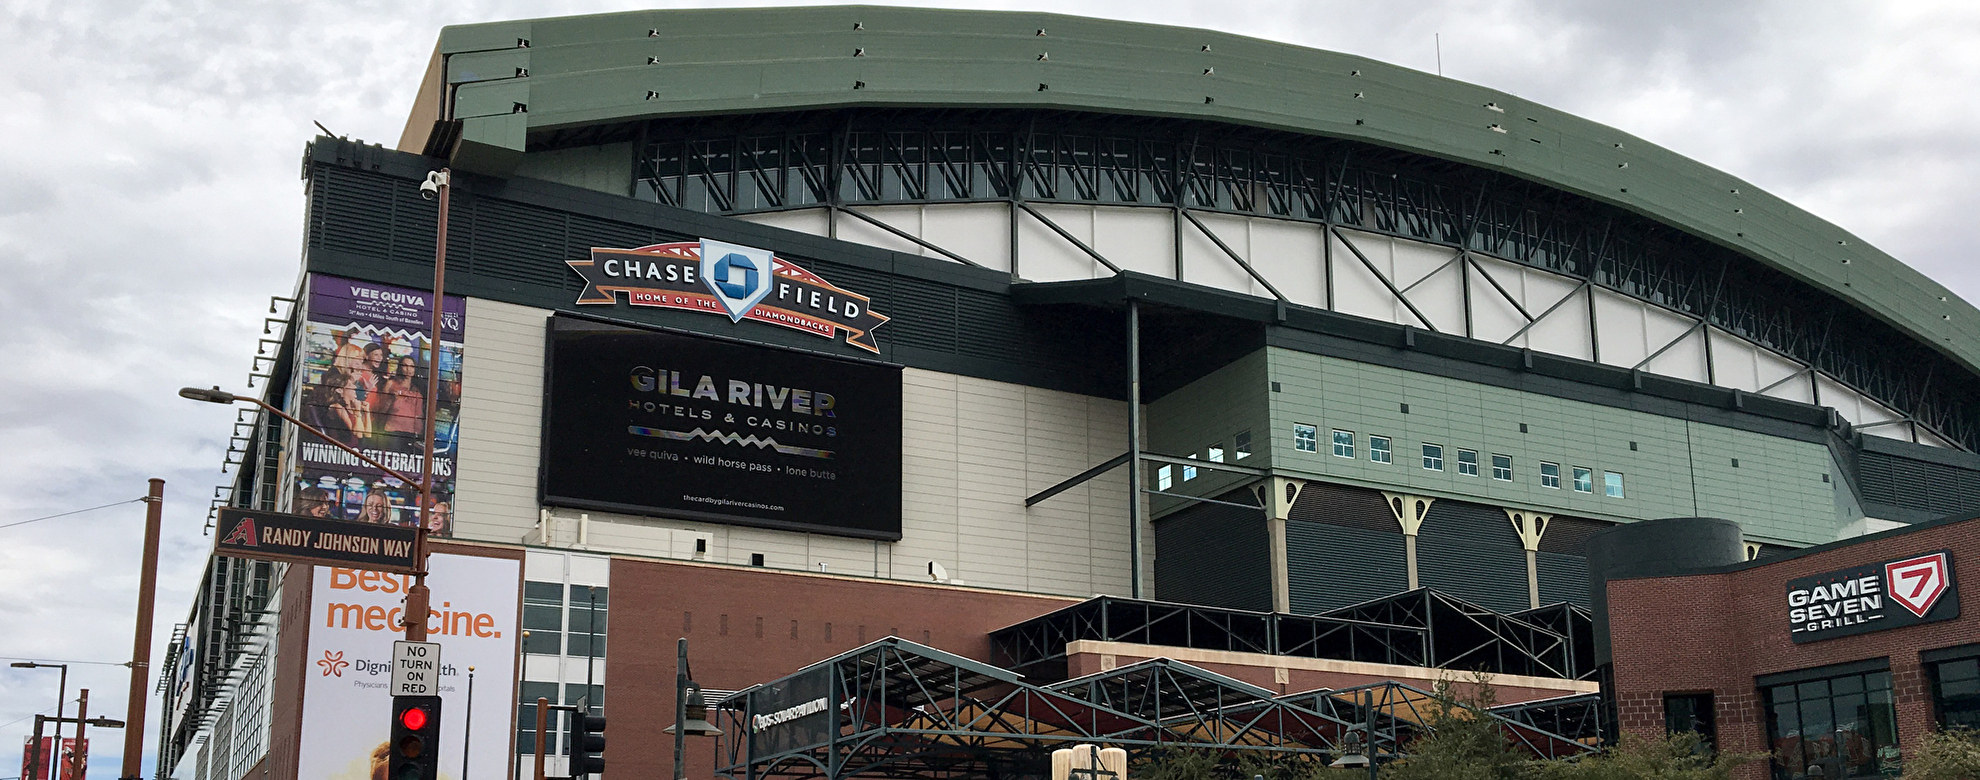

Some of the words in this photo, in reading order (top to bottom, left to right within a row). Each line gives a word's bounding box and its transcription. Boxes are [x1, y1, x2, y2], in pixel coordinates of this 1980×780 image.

[350, 286, 379, 299] VEE
[380, 291, 425, 307] QUIVA
[604, 259, 695, 284] CHASE
[779, 283, 859, 318] FIELD
[356, 304, 380, 312] HOTEL
[390, 310, 418, 318] CASINO
[636, 293, 666, 303] HOME
[697, 299, 716, 308] THE
[755, 308, 830, 332] DIAMONDBACKS
[630, 366, 720, 402] GILA
[728, 380, 836, 418] RIVER
[630, 400, 712, 420] HOTELS
[724, 413, 734, 424] &
[747, 416, 837, 438] CASINOS
[302, 442, 359, 466] WINNING
[362, 450, 452, 476] CELEBRATNS
[627, 448, 646, 458] vee
[650, 449, 678, 462] quiva
[694, 456, 715, 466] wild
[718, 457, 746, 470] horse
[749, 462, 772, 473] pass
[786, 466, 807, 478] lone
[810, 468, 836, 480] butte
[683, 494, 784, 512] thecardbygilarivercasinos.com
[262, 526, 312, 548] RANDY
[314, 532, 379, 554] JOHNSON
[383, 538, 412, 558] WAY
[1788, 575, 1881, 607] GAME
[1901, 567, 1932, 598] 7
[326, 601, 502, 638] mecine.
[1790, 594, 1883, 624] SEVEN
[1806, 614, 1867, 632] GRILL
[400, 659, 432, 670] TURN
[407, 646, 427, 658] NO
[355, 659, 392, 676] Digni
[408, 672, 424, 682] ON
[354, 680, 388, 690] Physicians
[438, 683, 456, 692] pitals
[402, 684, 427, 694] RED
